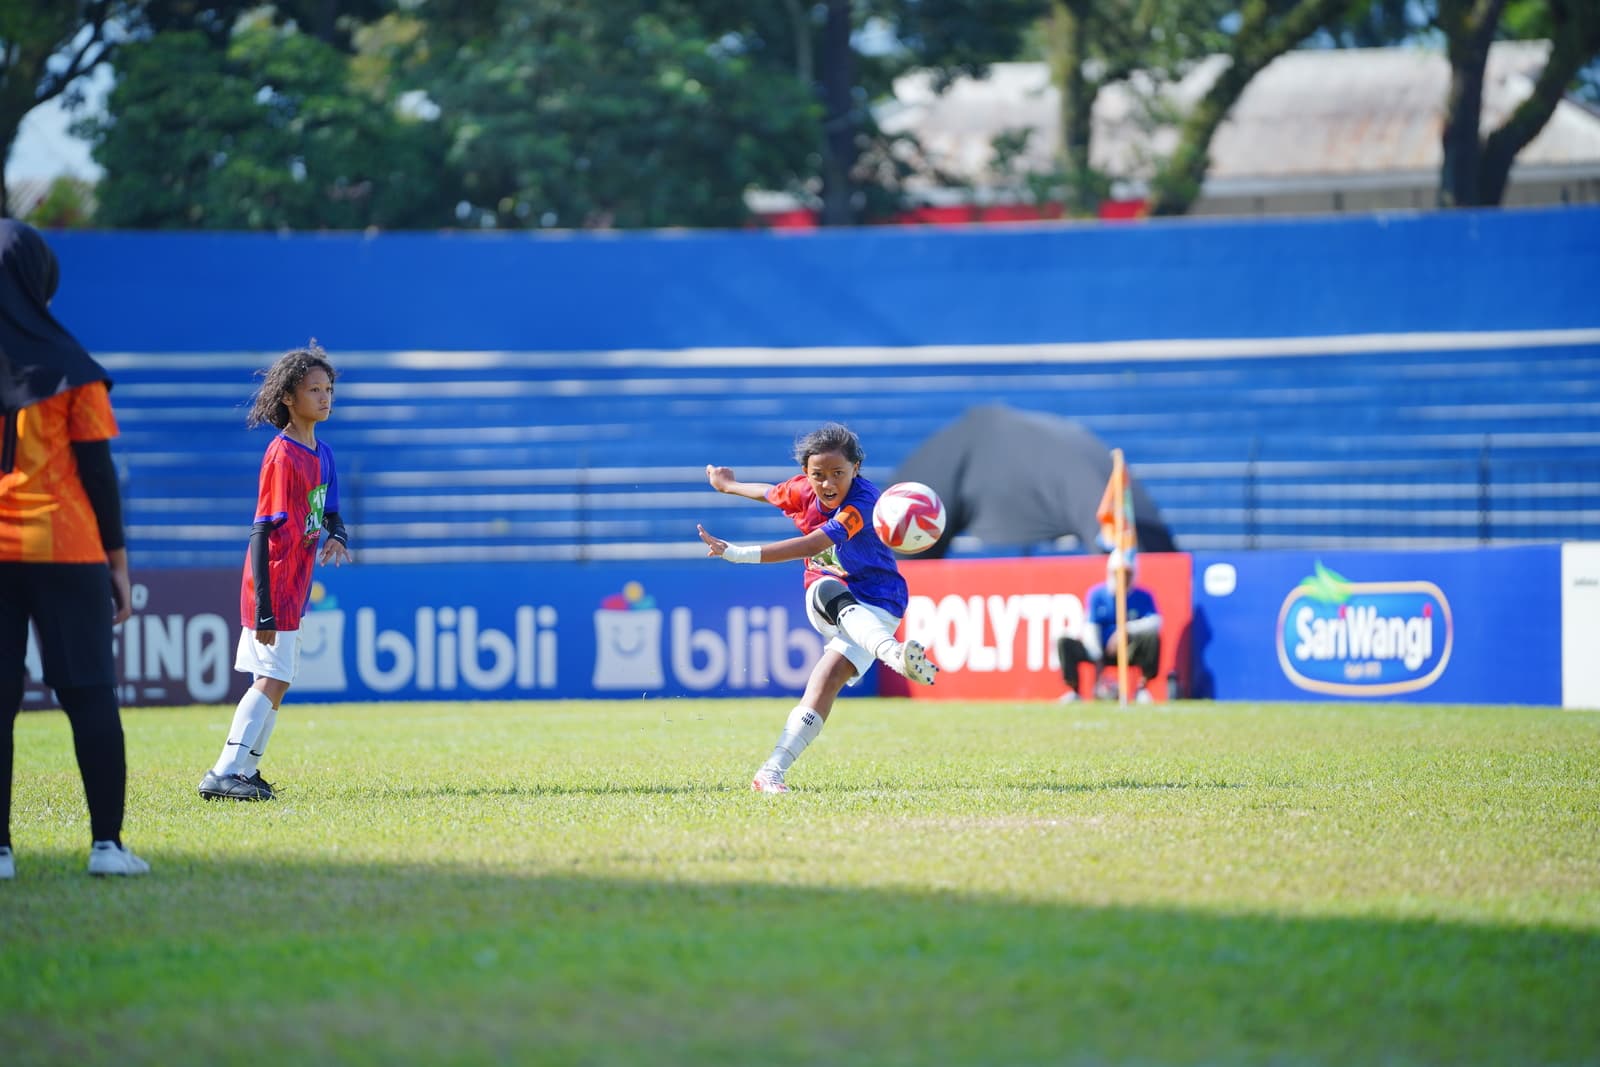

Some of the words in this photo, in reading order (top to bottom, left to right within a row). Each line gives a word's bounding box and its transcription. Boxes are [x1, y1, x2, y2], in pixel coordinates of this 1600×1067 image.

[356, 606, 557, 692] blibli
[671, 606, 823, 690] blib
[1295, 603, 1433, 670] SariWangi
